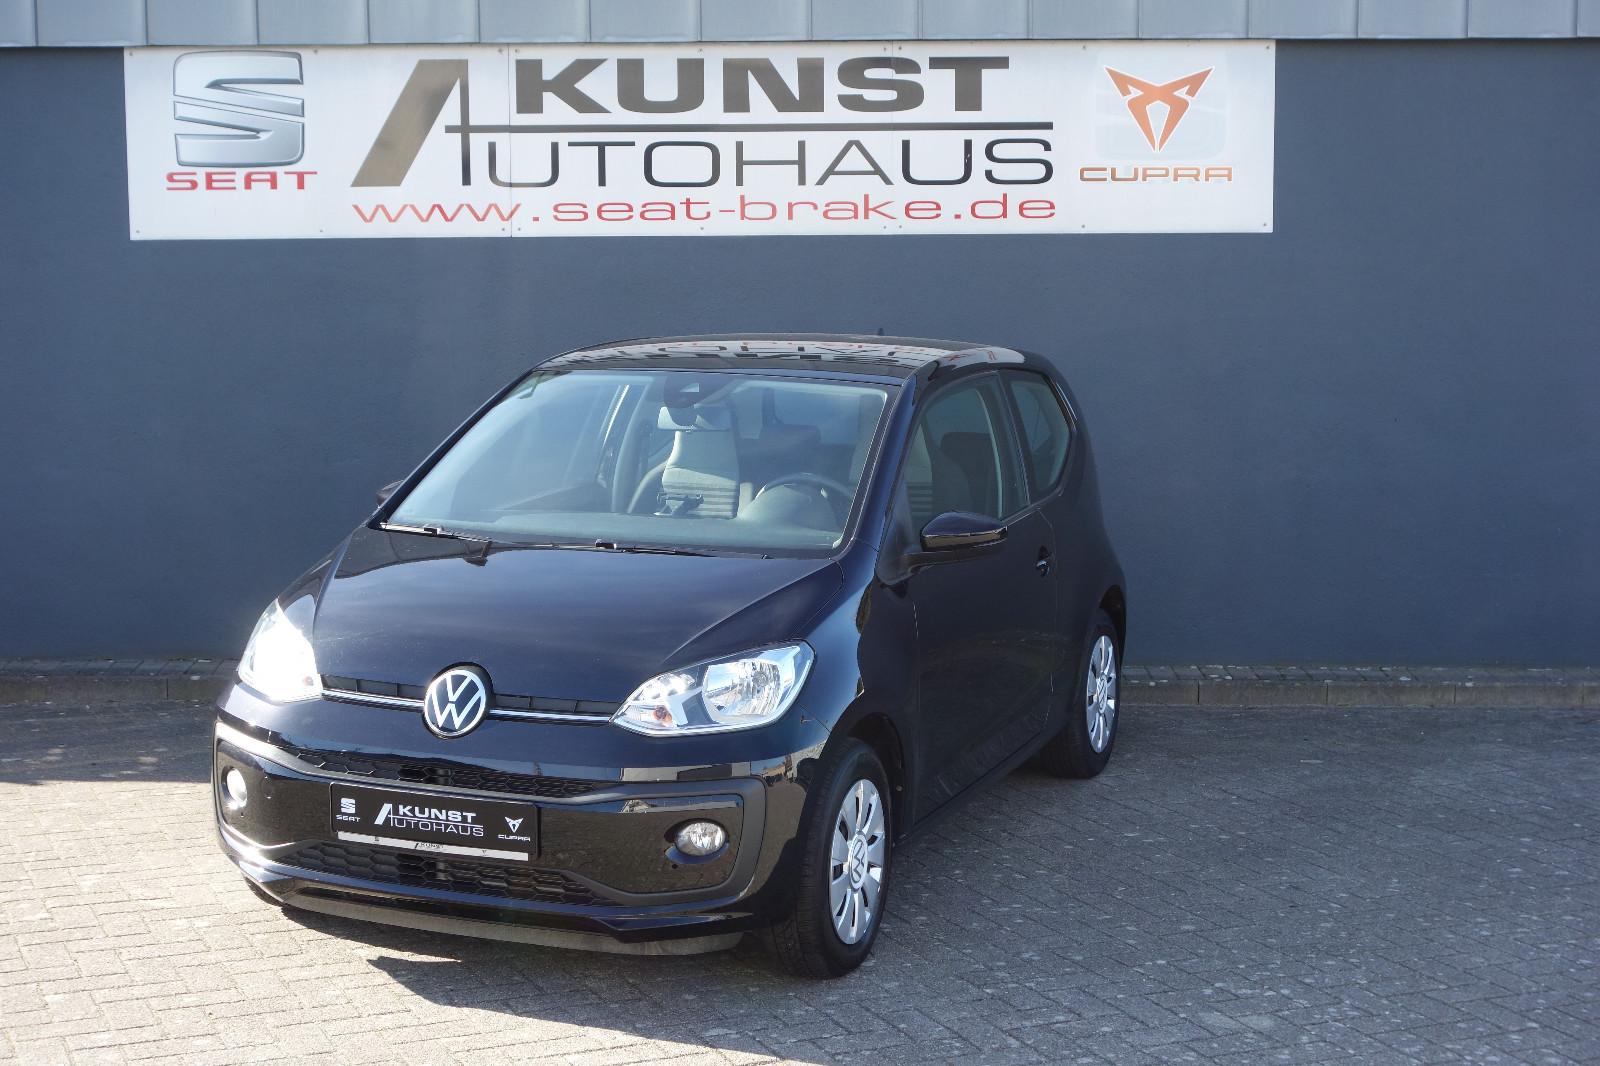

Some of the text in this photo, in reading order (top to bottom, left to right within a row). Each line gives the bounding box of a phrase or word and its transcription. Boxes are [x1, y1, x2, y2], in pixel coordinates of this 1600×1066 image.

[515, 56, 1010, 115] KUNST
[350, 58, 1055, 188] AUTOHAUS
[165, 171, 318, 191] SEAT
[1079, 164, 1234, 184] CUPRA
[352, 193, 1057, 224] www.seat-brake.de
[335, 814, 361, 823] SEAT
[373, 803, 484, 837] AUTOHAUS
[398, 804, 477, 824] KUNST
